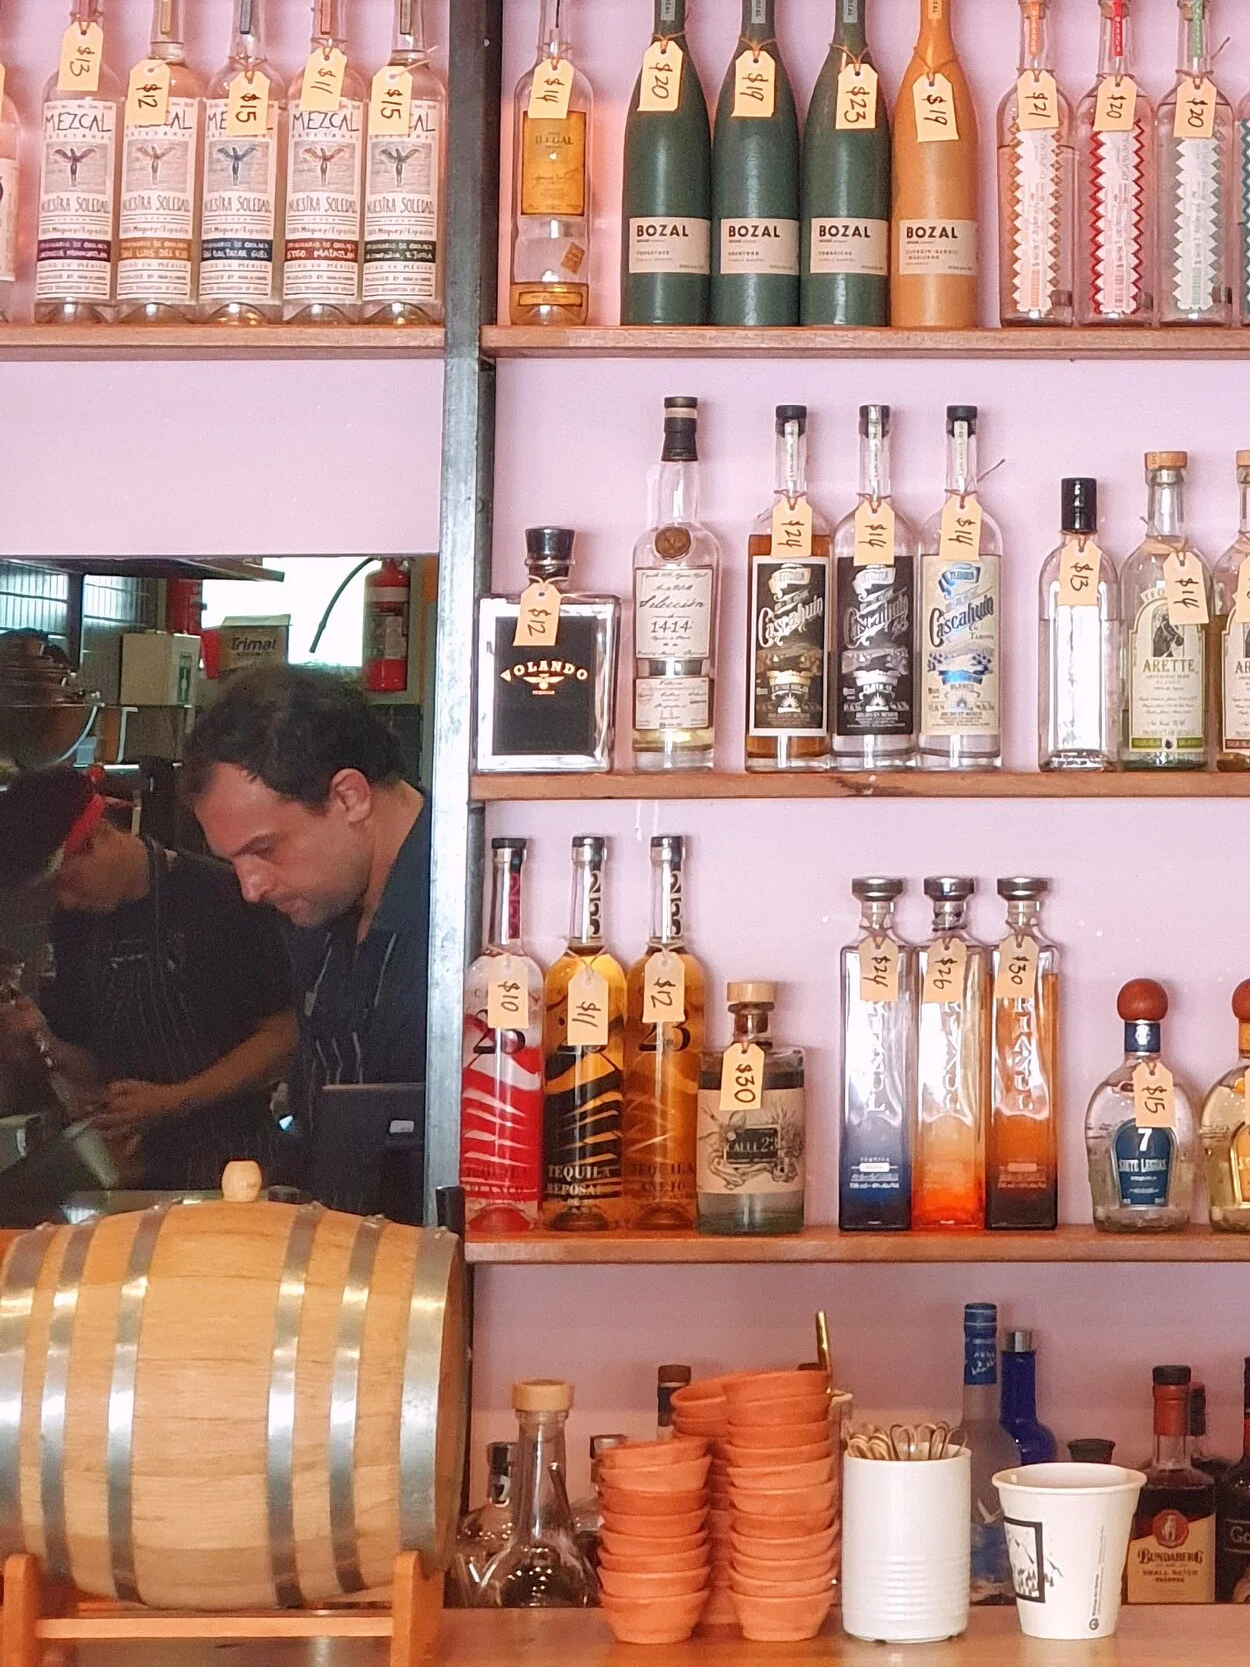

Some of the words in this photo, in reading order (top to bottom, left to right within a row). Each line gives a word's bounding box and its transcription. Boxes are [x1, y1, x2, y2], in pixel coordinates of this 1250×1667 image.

[67, 45, 92, 78] $13
[310, 67, 334, 94] $11
[534, 78, 559, 104] $14
[650, 65, 672, 100] $20
[739, 75, 768, 102] $19
[136, 83, 163, 108] $12
[235, 93, 262, 123] $15
[379, 89, 404, 119] $15
[844, 88, 869, 124] $23
[1027, 91, 1052, 119] $21
[1106, 93, 1126, 120] $20
[45, 112, 112, 132] MEZCAL
[293, 111, 360, 132] MEZCAL
[923, 94, 948, 125] $19
[1187, 99, 1209, 129] $20
[637, 225, 689, 237] BOZAL
[728, 225, 781, 238] BOZAL
[819, 225, 871, 238] BOZAL
[906, 226, 958, 239] BOZAL
[777, 522, 804, 549] $24
[857, 524, 888, 549] $14
[947, 518, 977, 547] $14
[1069, 562, 1095, 592] $13
[1173, 576, 1200, 609] $14
[527, 608, 549, 636] $12
[651, 620, 693, 633] 1414
[499, 659, 589, 682] VOLANDO
[1142, 659, 1195, 672] ARETTE
[862, 953, 889, 987] $24
[930, 957, 958, 990] $26
[1011, 955, 1031, 985] $30
[498, 979, 520, 1012] $10
[649, 978, 677, 1008] $12
[572, 1001, 602, 1026] $11
[733, 1064, 756, 1103] $30
[1141, 1083, 1168, 1114] $15
[760, 1136, 777, 1152] 23
[1138, 1129, 1153, 1151] 7
[547, 1165, 612, 1181] TEQUILA
[1138, 1549, 1204, 1565] BUNDABERG
